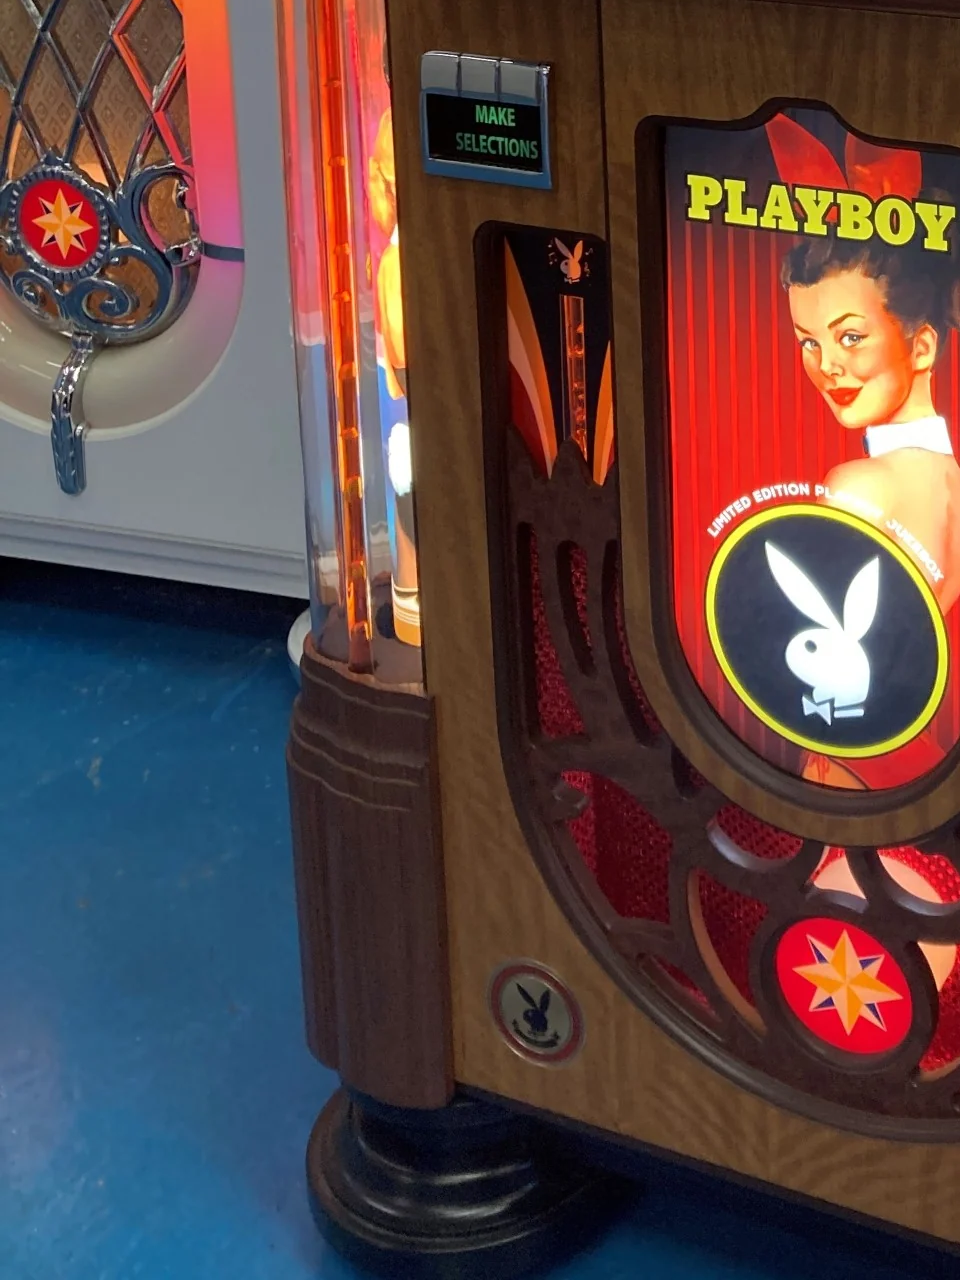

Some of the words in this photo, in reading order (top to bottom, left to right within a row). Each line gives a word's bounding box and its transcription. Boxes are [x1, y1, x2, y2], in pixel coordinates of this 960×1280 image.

[475, 104, 516, 127] MAKE
[455, 132, 539, 159] SELECTIONS
[687, 174, 956, 252] PLAYBOY
[707, 495, 751, 538] LIMITED
[752, 482, 810, 503] EDITION
